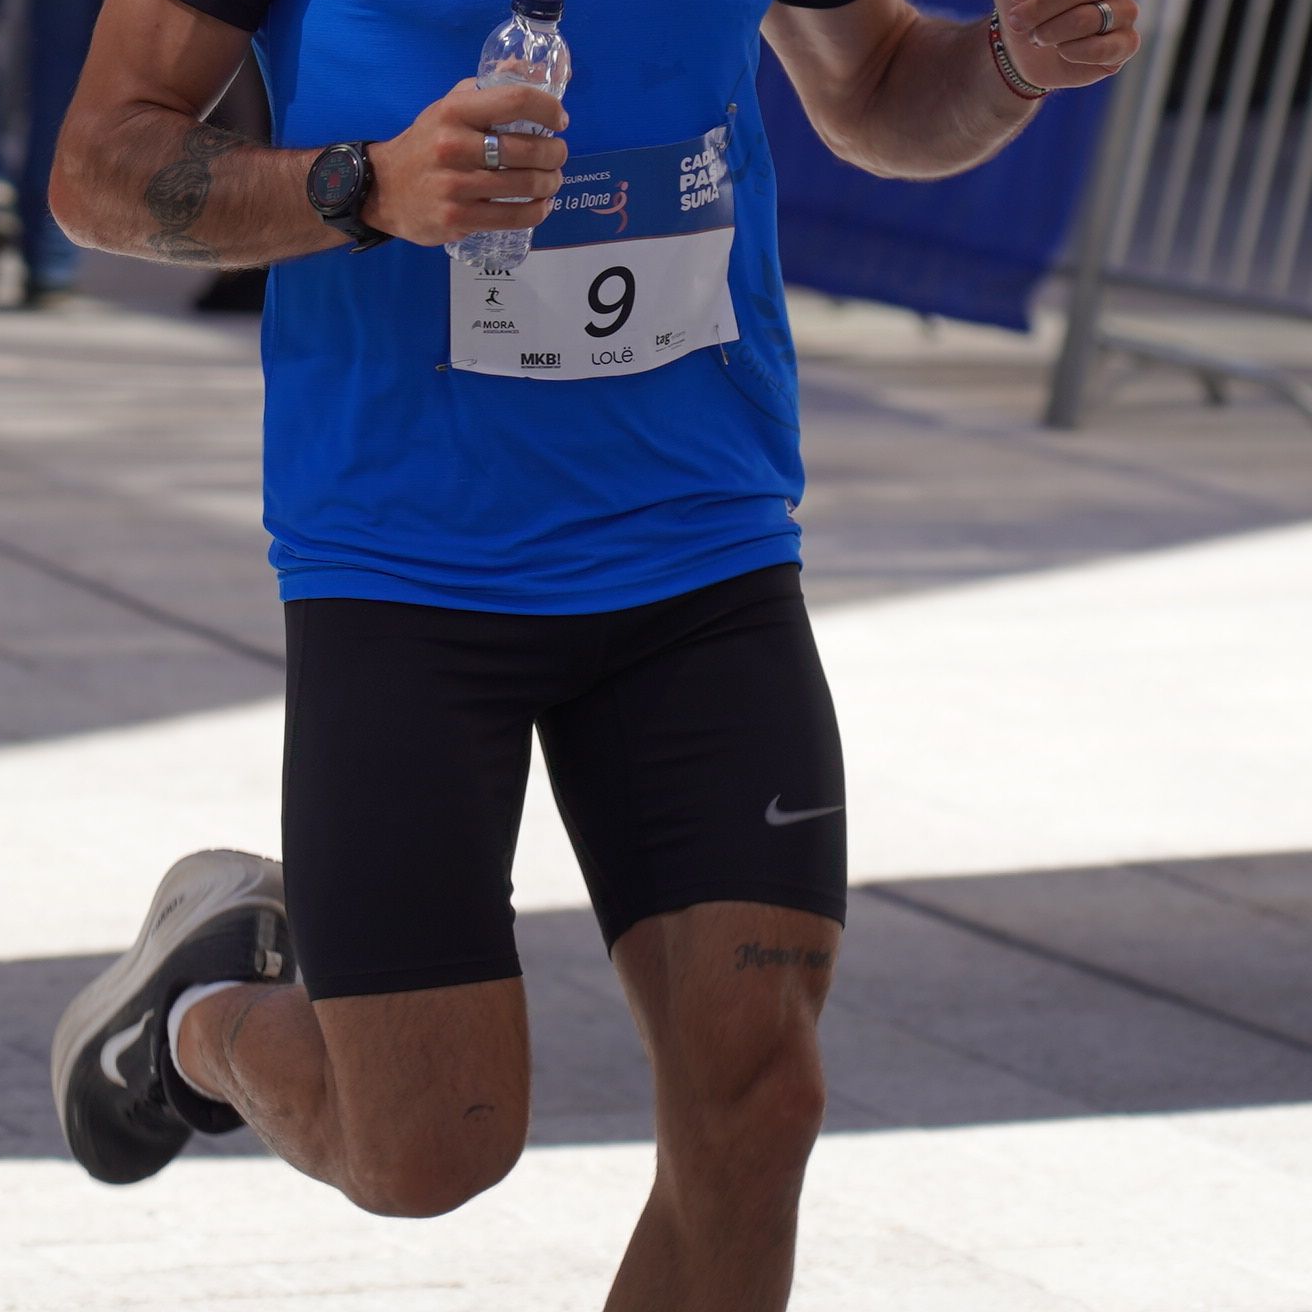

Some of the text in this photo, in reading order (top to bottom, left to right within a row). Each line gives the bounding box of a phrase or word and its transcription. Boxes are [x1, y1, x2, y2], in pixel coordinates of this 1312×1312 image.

[561, 170, 612, 185] EGURANCES
[565, 195, 579, 210] la
[580, 192, 611, 209] Dona
[680, 184, 720, 212] SUMA
[584, 265, 636, 338] 9
[483, 320, 515, 330] MORA
[520, 353, 561, 366] MKB!
